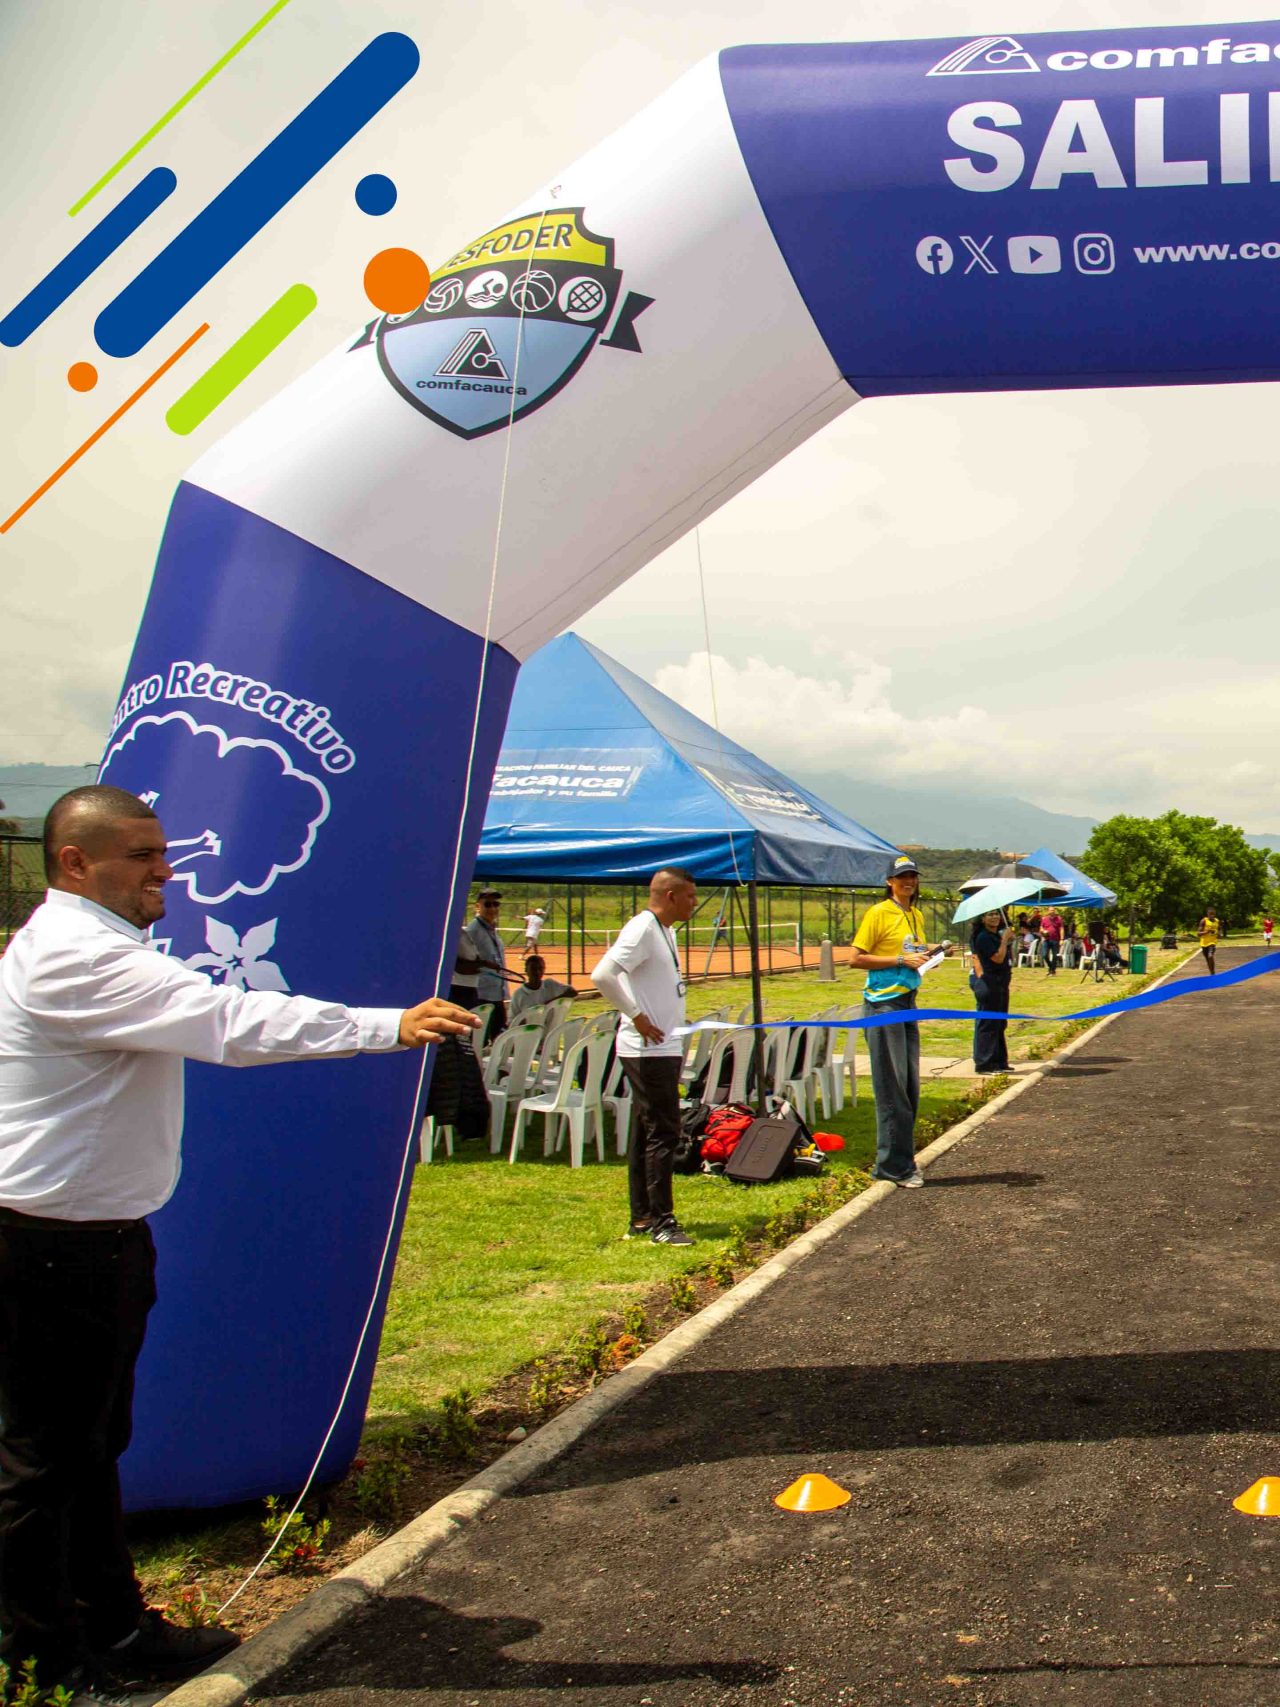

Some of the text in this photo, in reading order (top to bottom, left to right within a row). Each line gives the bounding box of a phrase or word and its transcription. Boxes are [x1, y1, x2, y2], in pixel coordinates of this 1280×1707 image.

[446, 224, 574, 268] ESFODER
[416, 379, 528, 396] comfacauca
[165, 660, 356, 774] Recreativo
